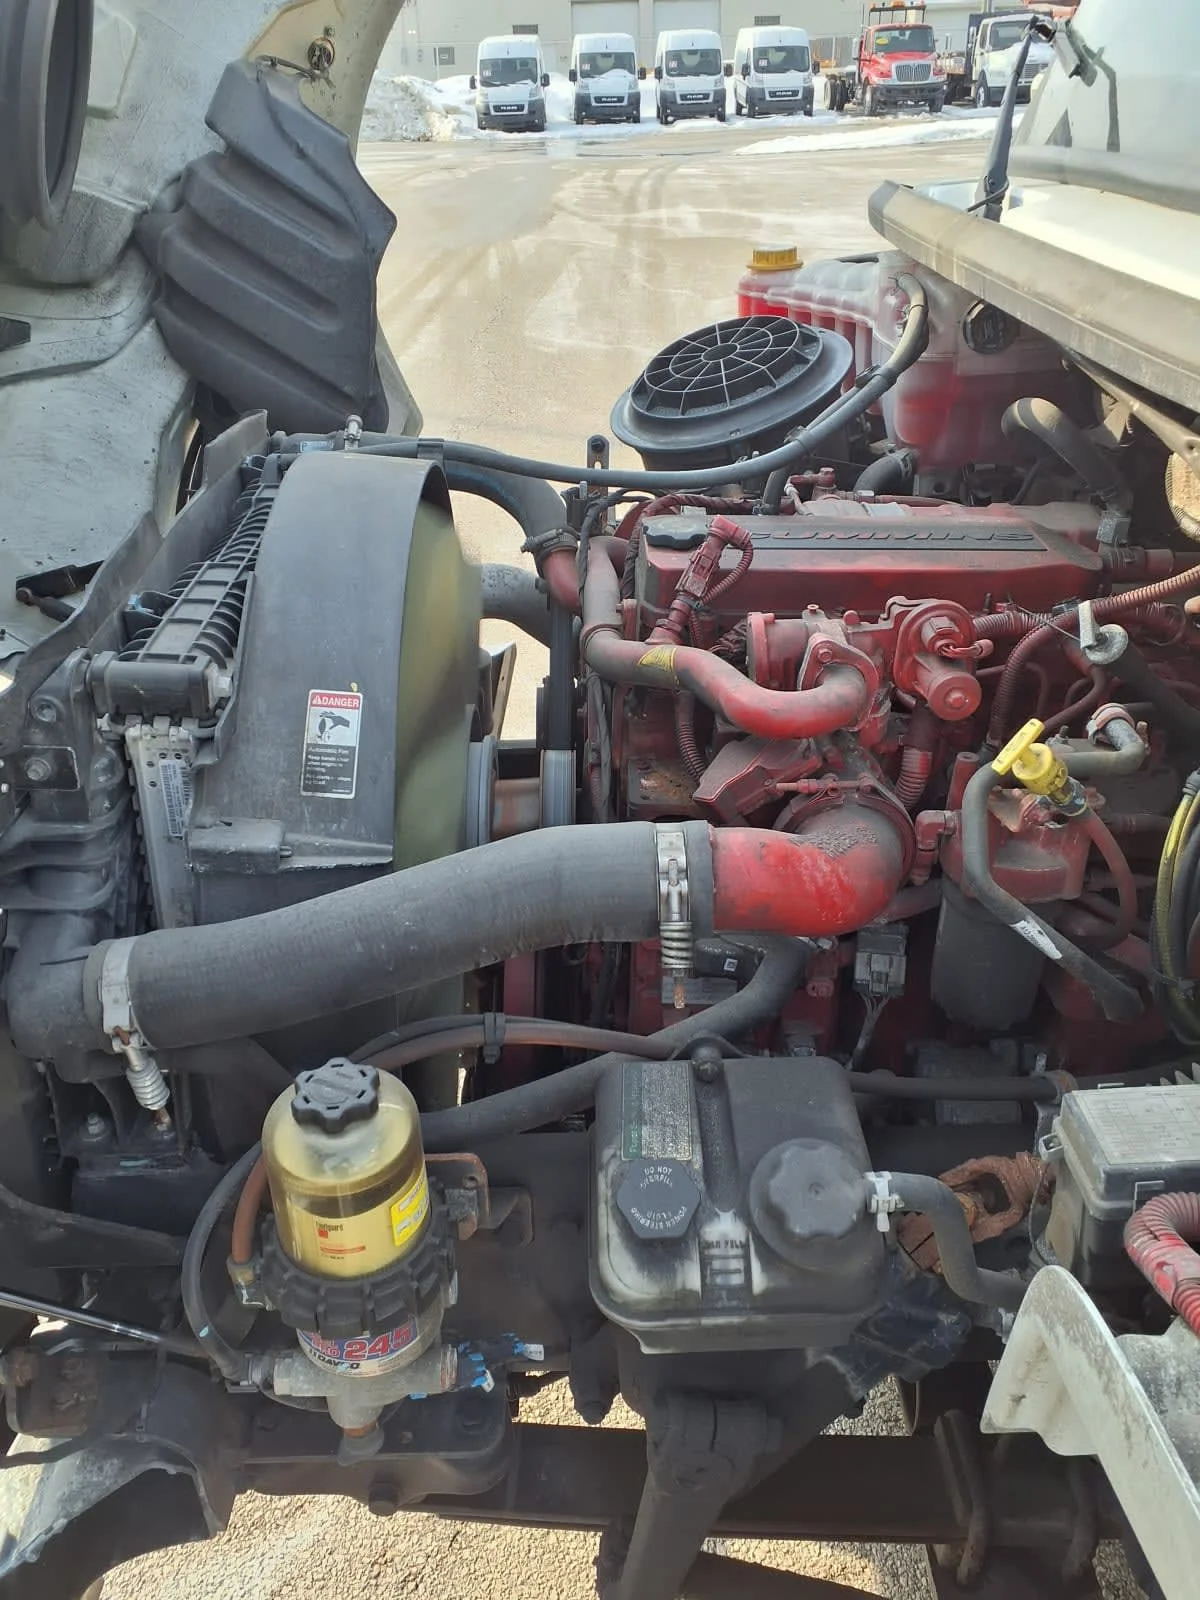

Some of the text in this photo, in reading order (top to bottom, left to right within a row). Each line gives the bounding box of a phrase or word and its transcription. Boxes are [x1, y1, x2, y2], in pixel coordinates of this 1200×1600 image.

[322, 696, 360, 709] DANGER
[644, 1165, 673, 1176] DO NOT
[343, 1323, 413, 1361] 245
[317, 1354, 361, 1370] DAVO
